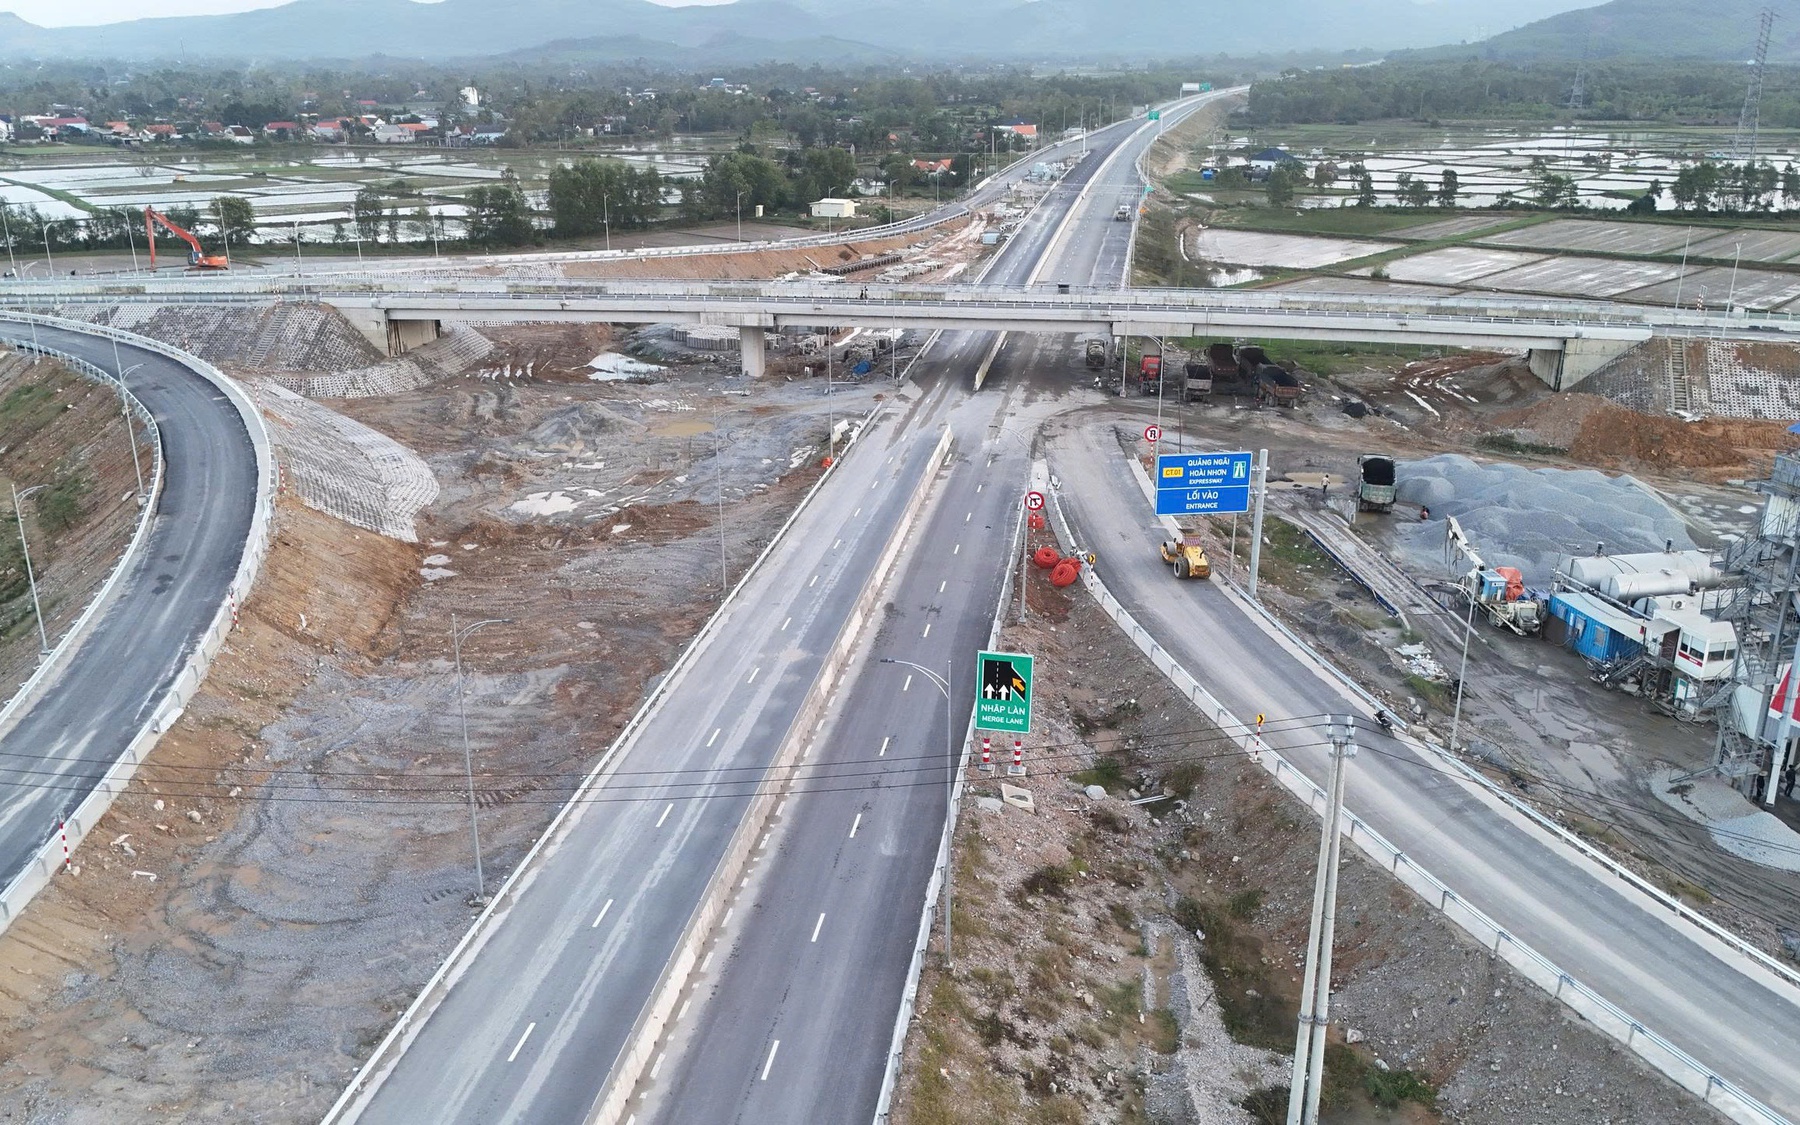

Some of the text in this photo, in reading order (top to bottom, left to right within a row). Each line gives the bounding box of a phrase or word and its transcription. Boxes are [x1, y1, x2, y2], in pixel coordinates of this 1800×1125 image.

[1187, 457, 1212, 467] QUẢNG
[1189, 468, 1206, 477] HOÀI
[1187, 489, 1219, 500] LỐI VÀO
[981, 703, 1026, 716] NHẬP LÀN
[981, 715, 1024, 725] MERGE LANE
